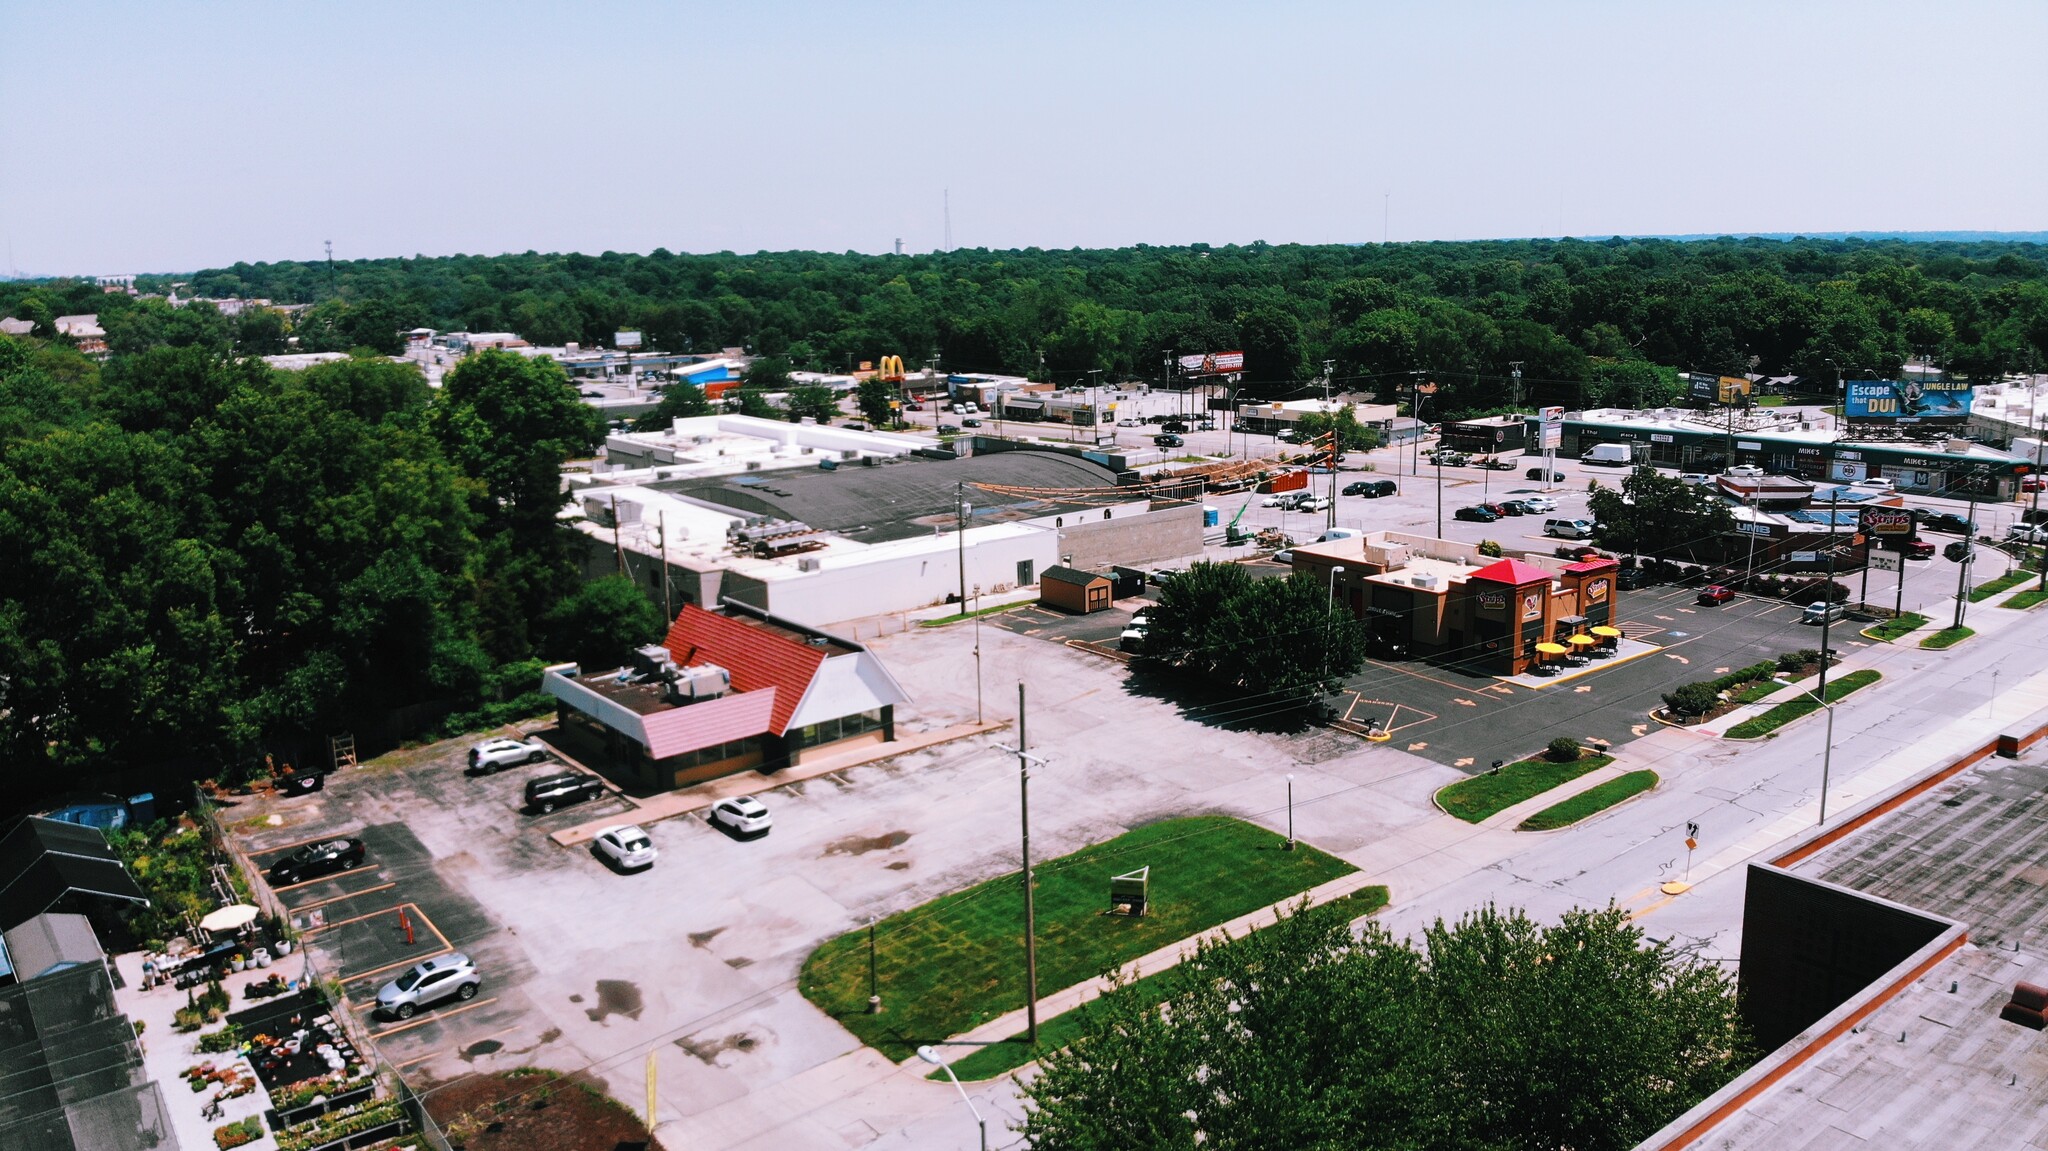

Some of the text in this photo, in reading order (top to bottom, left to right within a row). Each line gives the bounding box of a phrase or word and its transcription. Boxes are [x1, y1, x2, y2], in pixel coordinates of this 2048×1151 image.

[1852, 385, 1890, 396] Escape
[1922, 383, 1950, 391] JUNGLE
[1868, 399, 1896, 413] DUI
[1798, 447, 1821, 456] MIKE'S
[1903, 458, 1928, 466] MIKE'S
[1736, 522, 1771, 534] UMB
